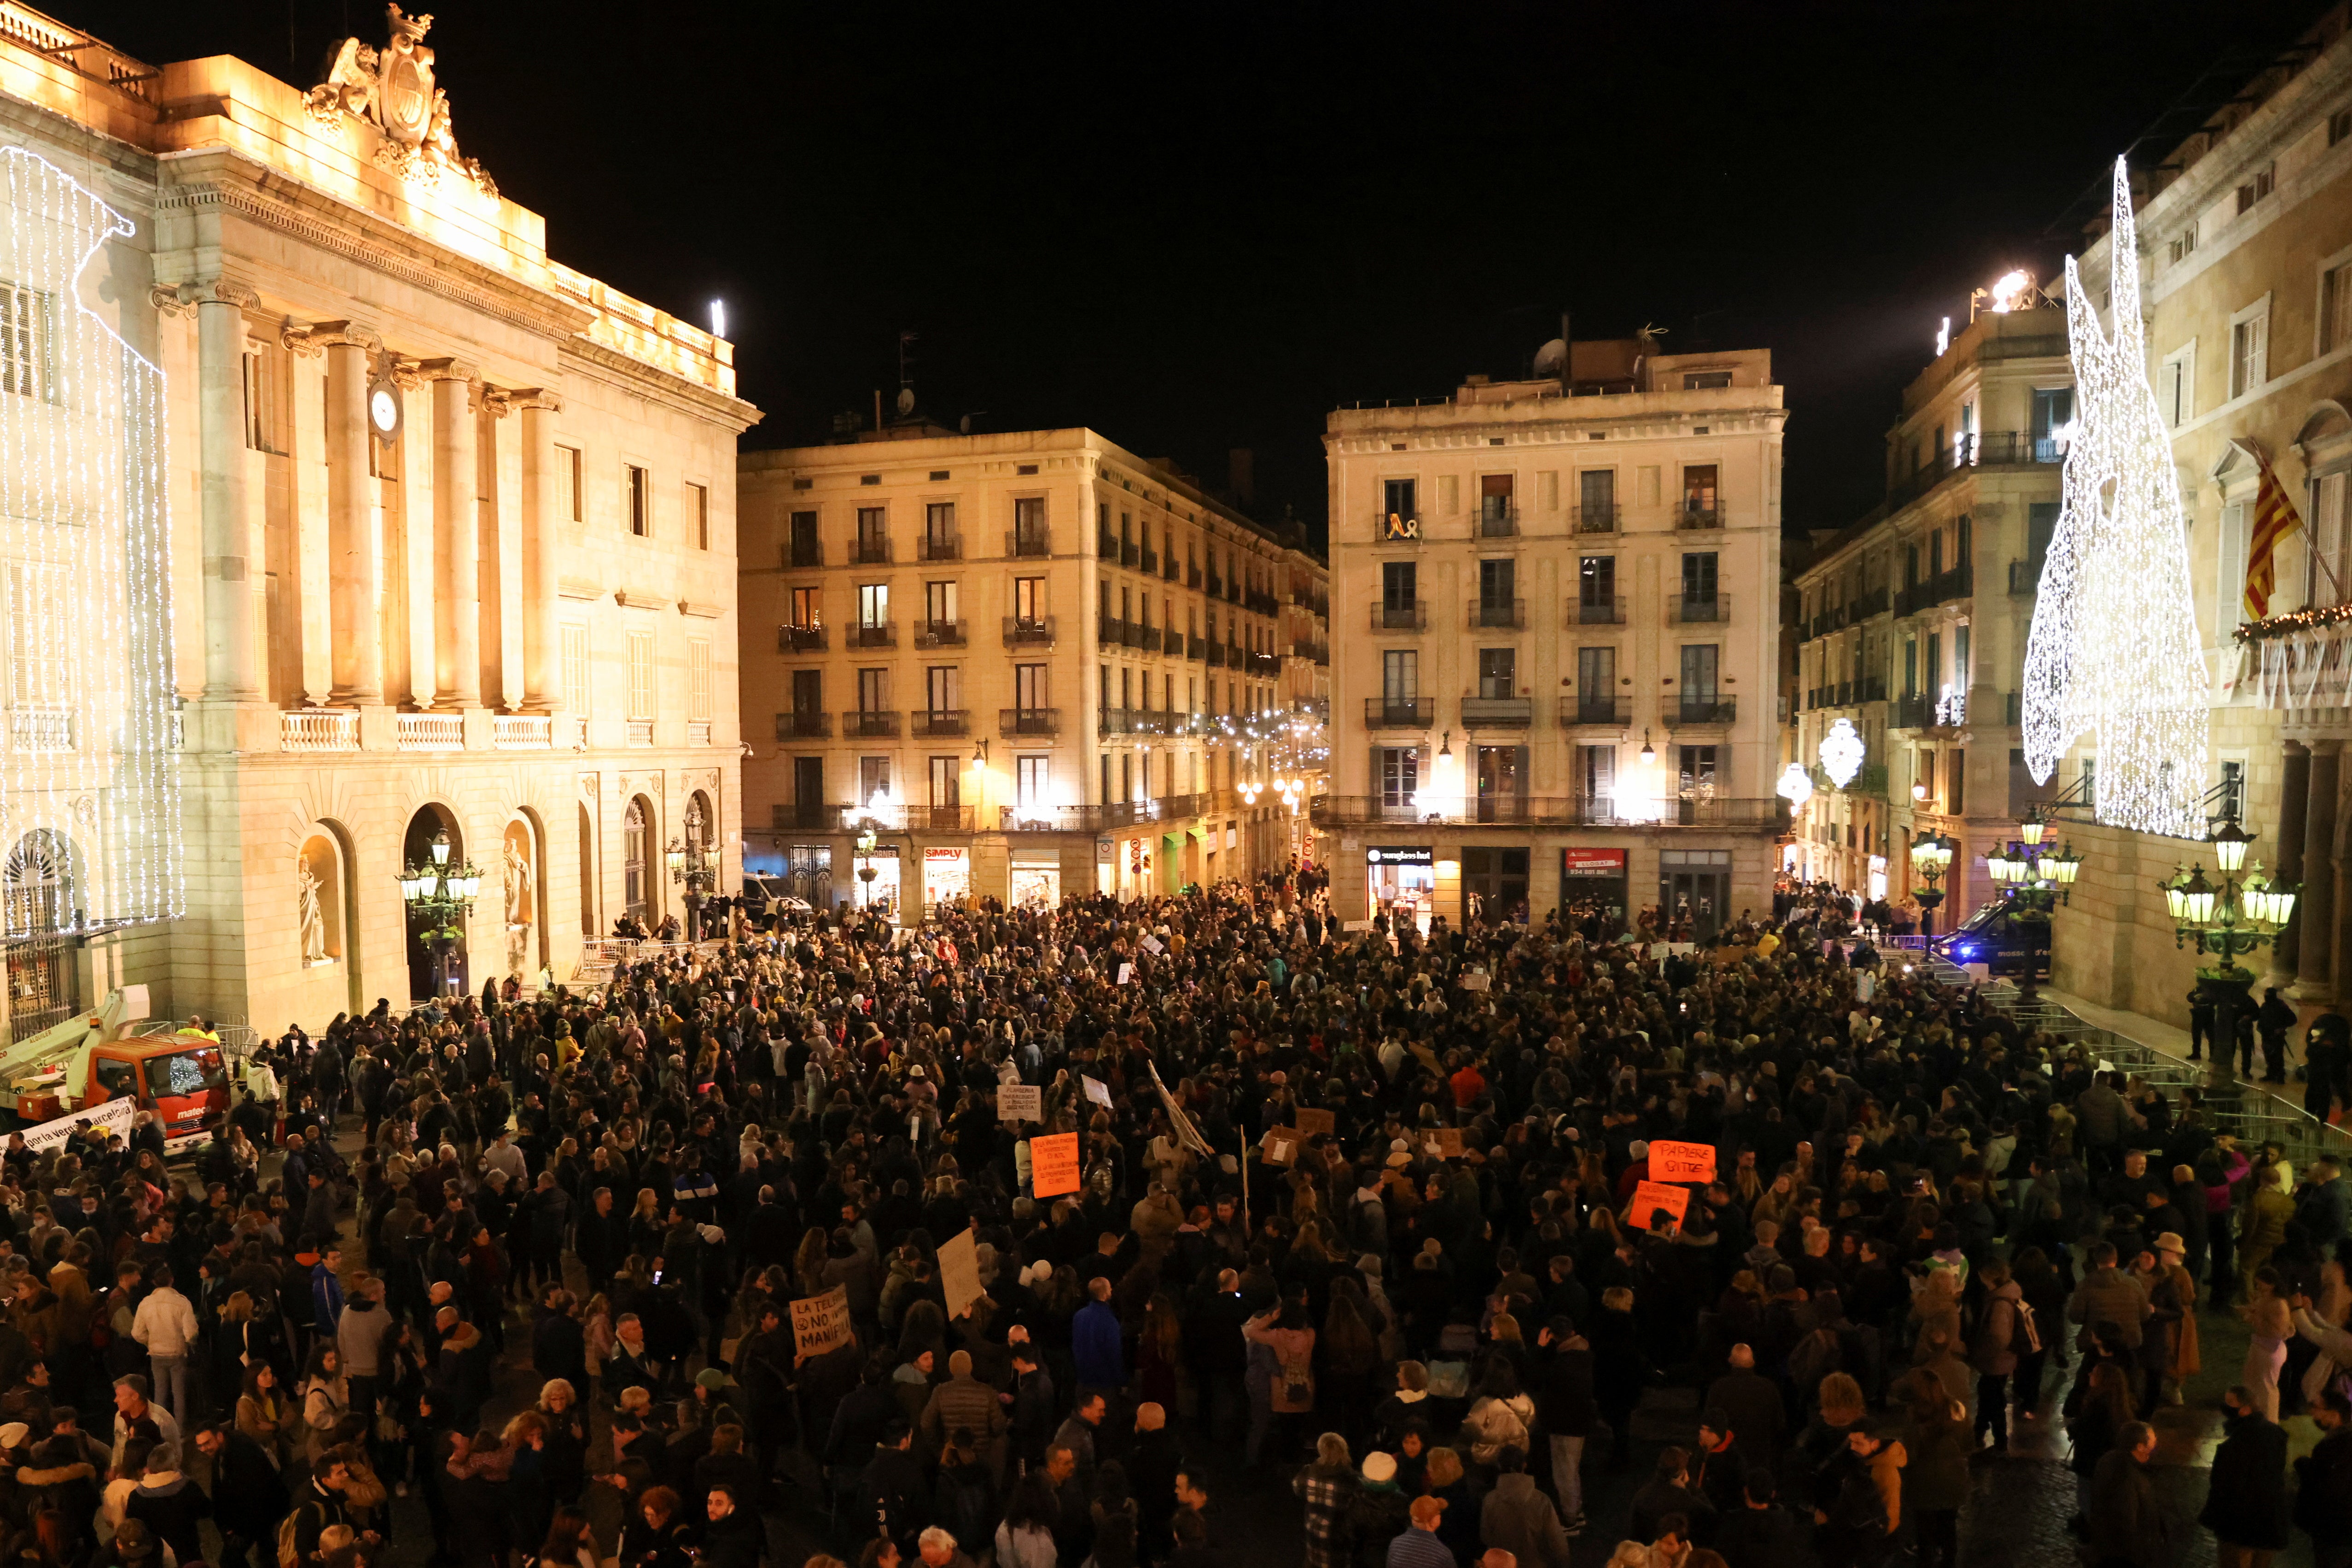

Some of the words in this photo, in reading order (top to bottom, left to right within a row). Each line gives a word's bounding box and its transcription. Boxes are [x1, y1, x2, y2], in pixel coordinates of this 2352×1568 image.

[1381, 851, 1416, 861] sunglass
[1416, 851, 1431, 859] hut
[29, 1030, 52, 1043] ALQUILER
[177, 1105, 212, 1119] mateco
[26, 1136, 43, 1148] por
[41, 1133, 54, 1141] la
[92, 1106, 131, 1125] arcelona
[1659, 1143, 1709, 1160] PAPIERE
[1665, 1160, 1703, 1172] BITTE
[797, 1304, 811, 1314] LA
[811, 1313, 828, 1329] NO
